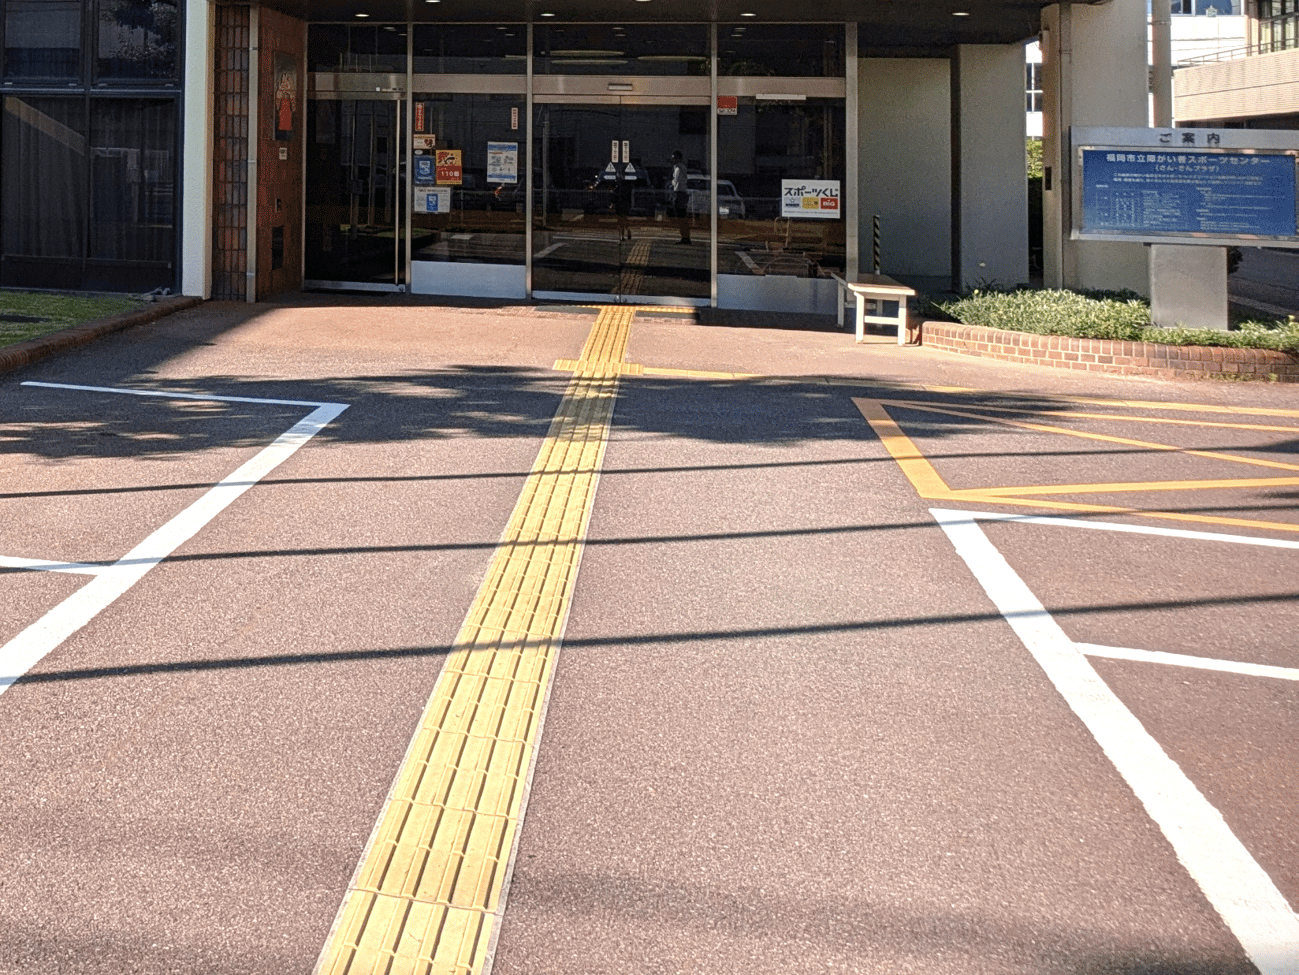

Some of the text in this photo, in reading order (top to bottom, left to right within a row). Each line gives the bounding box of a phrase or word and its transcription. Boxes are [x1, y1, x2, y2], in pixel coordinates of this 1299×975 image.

[784, 185, 839, 197] スポーツくじ
